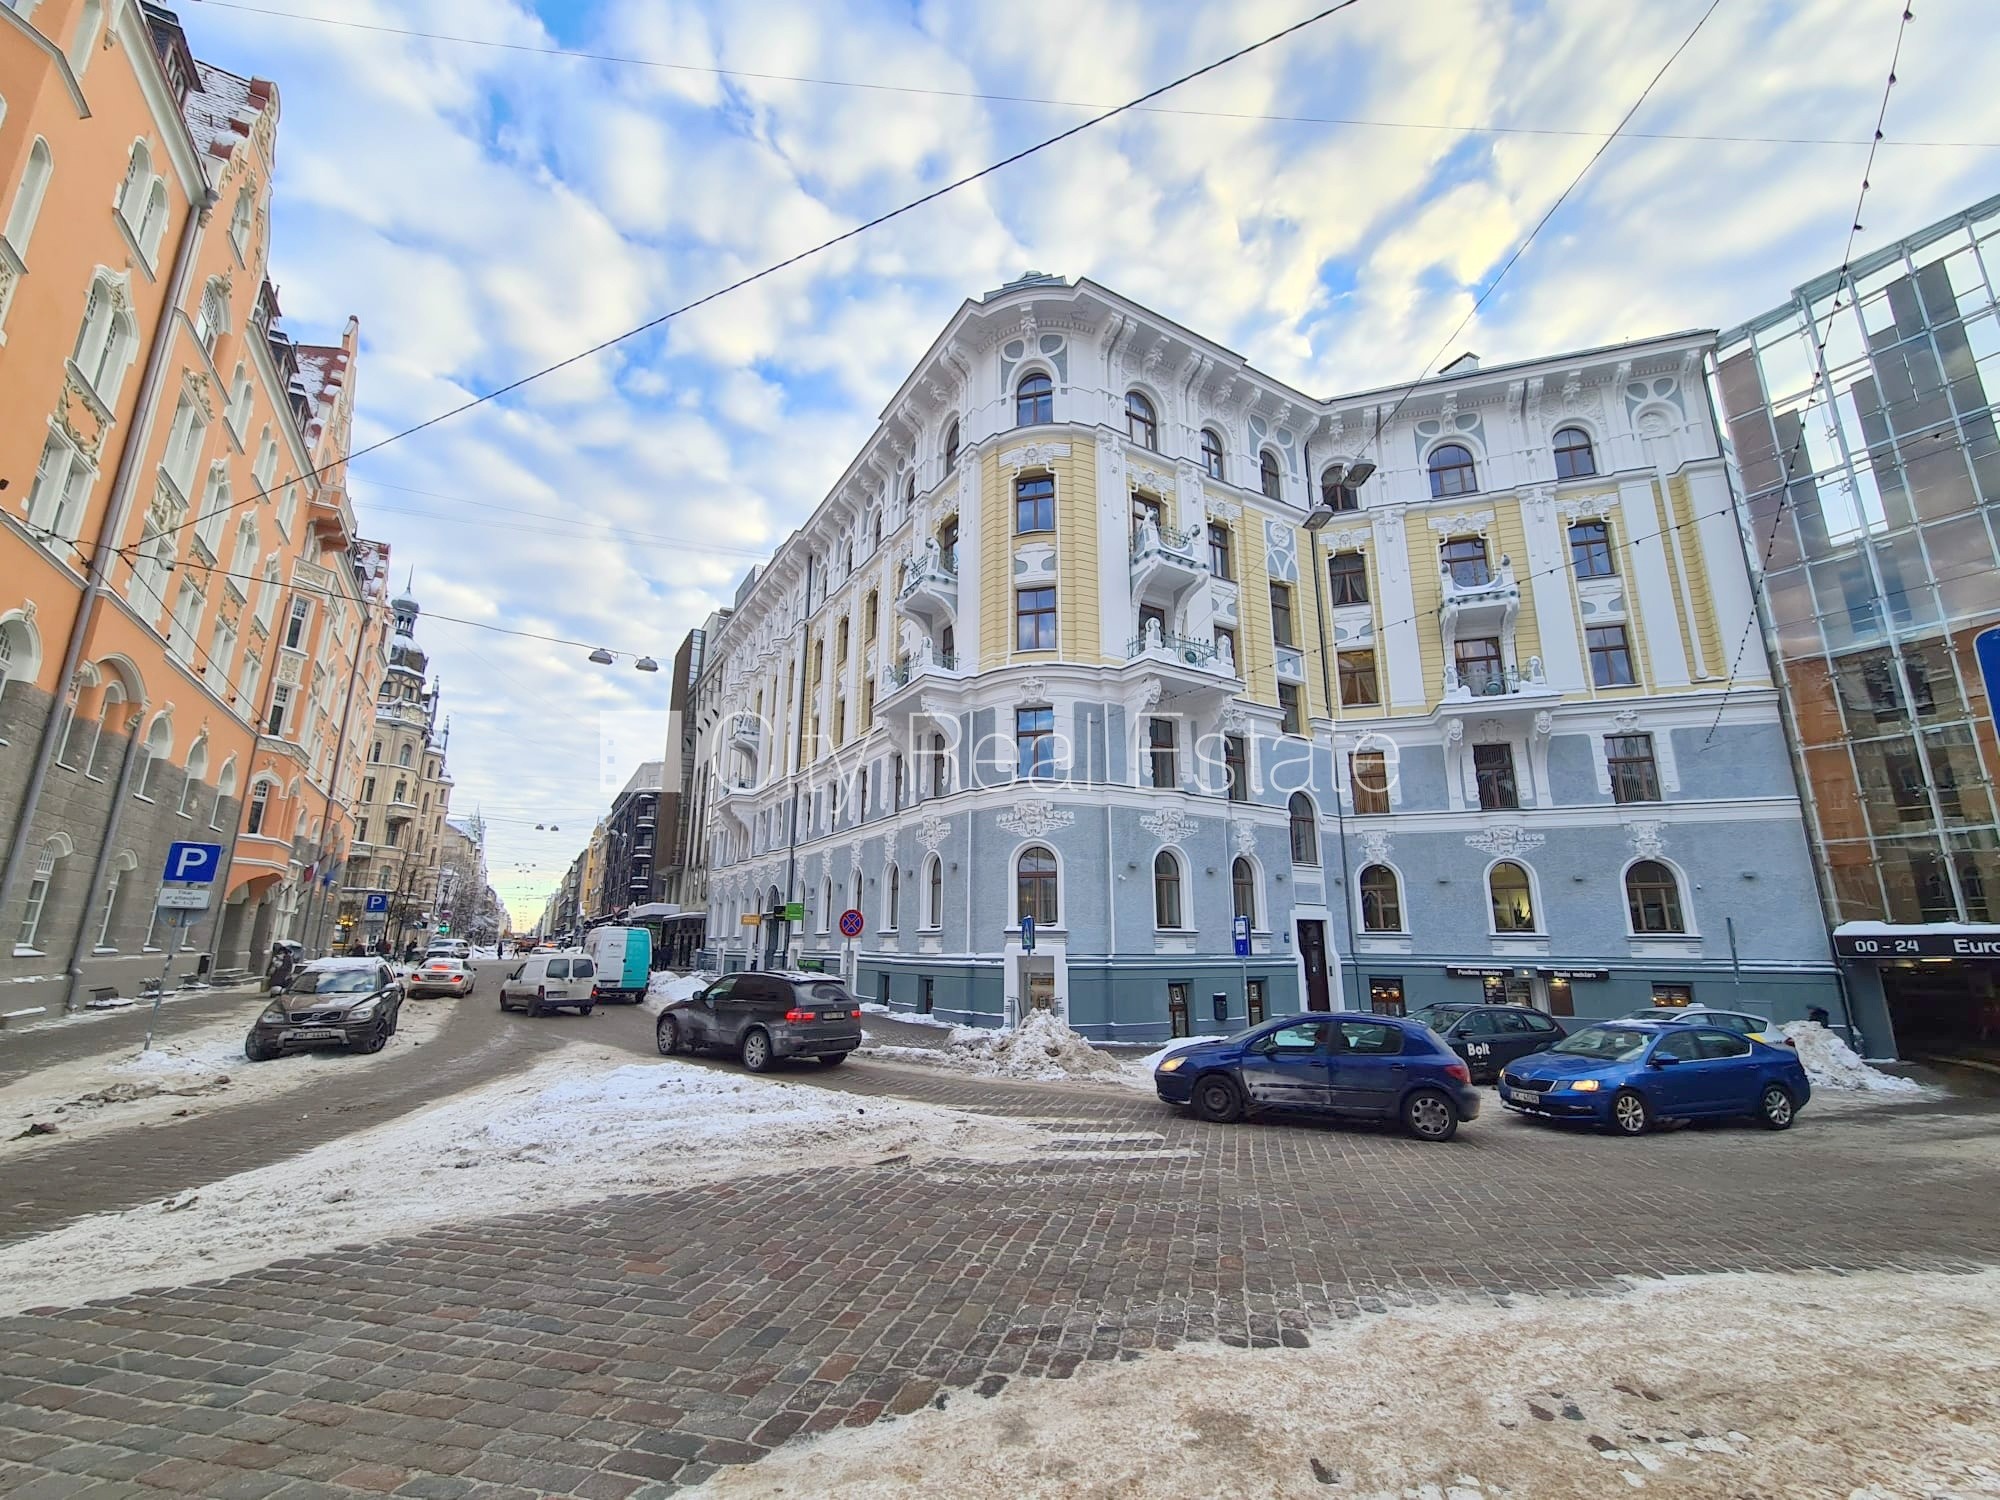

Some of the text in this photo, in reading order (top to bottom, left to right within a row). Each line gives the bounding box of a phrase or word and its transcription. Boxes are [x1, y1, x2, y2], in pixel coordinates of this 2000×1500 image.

[175, 847, 208, 877] P
[370, 896, 383, 909] P
[1854, 940, 1879, 953] 00
[1894, 940, 1920, 952] 24
[1467, 1042, 1491, 1056] Bolt
